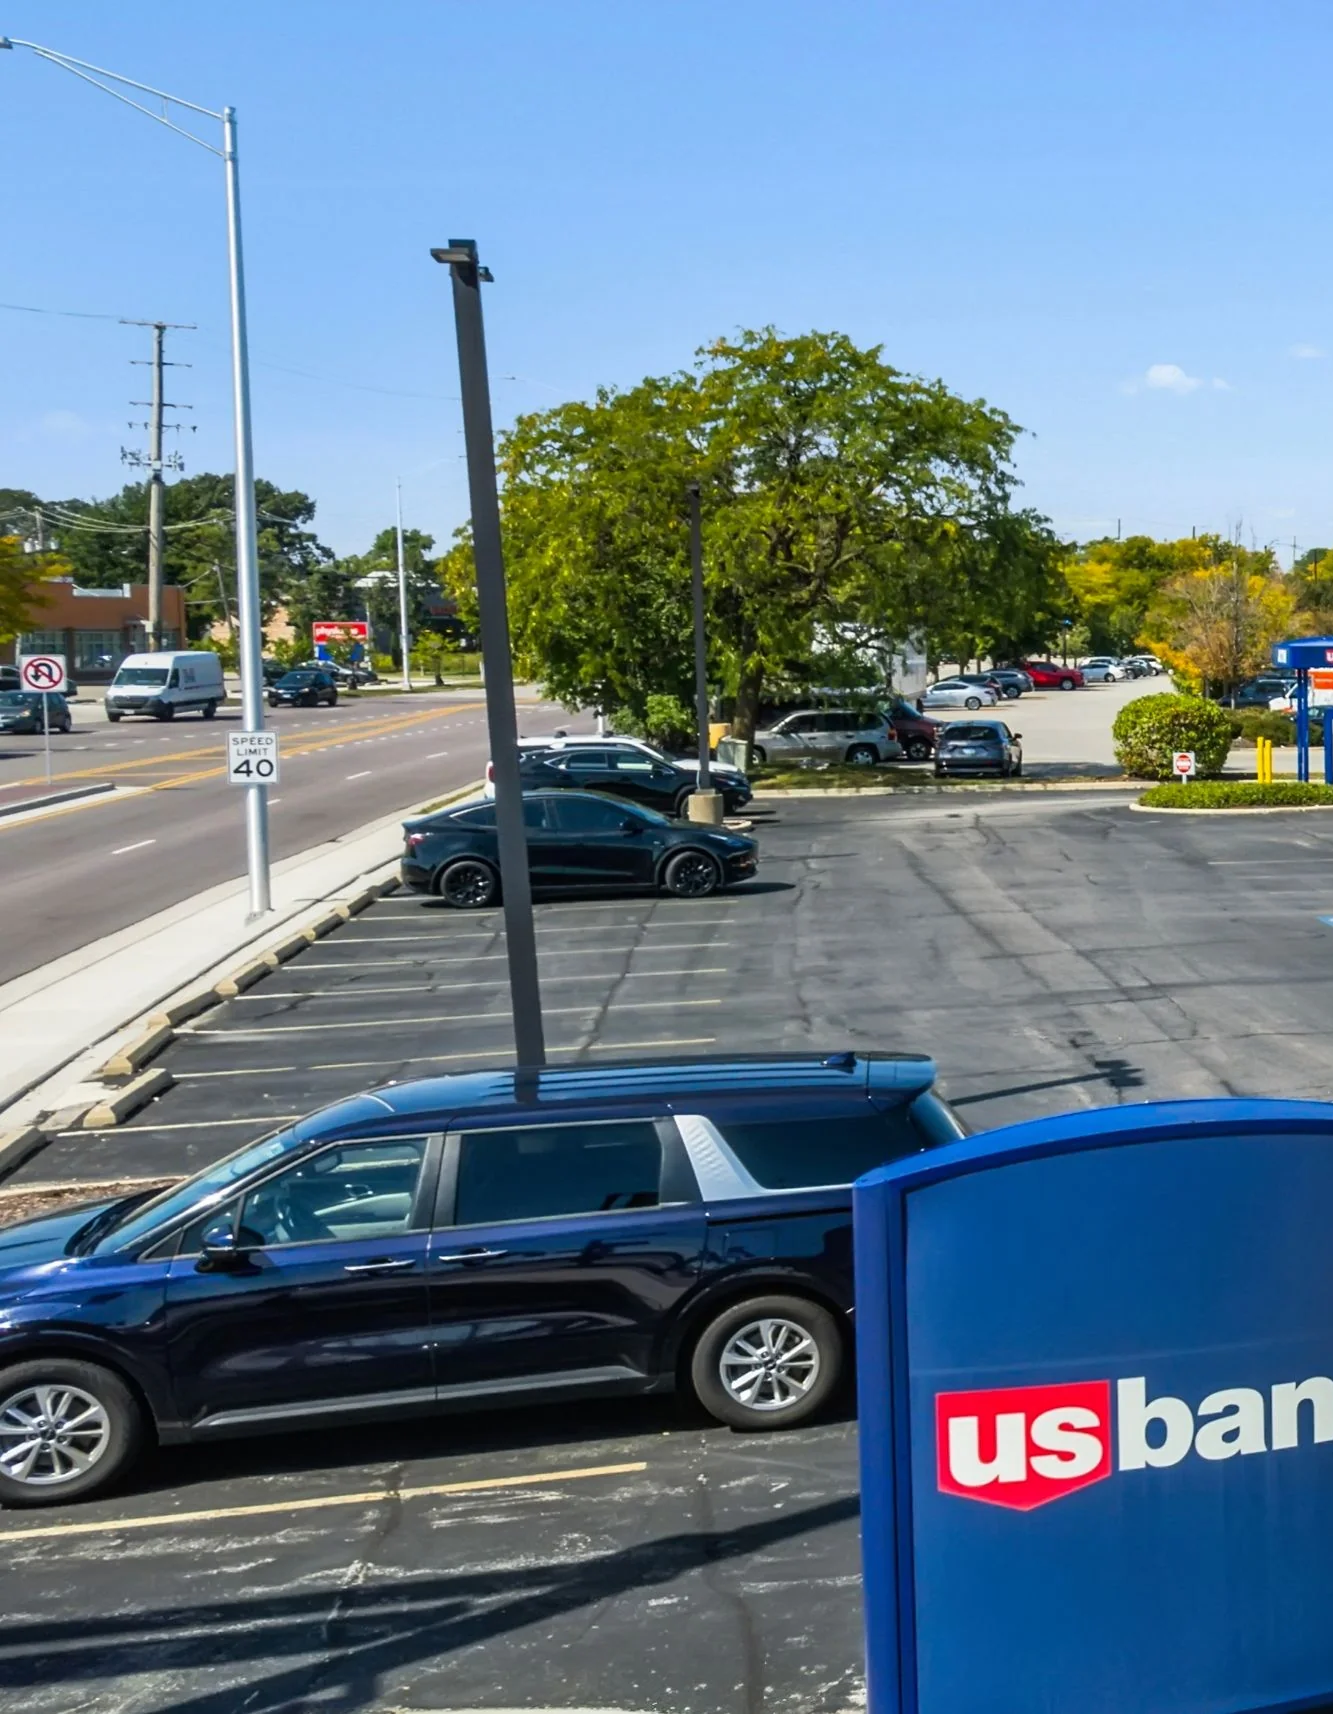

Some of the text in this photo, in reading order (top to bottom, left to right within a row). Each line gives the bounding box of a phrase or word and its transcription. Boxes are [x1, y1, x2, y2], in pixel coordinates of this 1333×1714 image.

[232, 737, 274, 746] SPEED
[236, 748, 268, 757] LIMIT
[233, 759, 274, 778] 40
